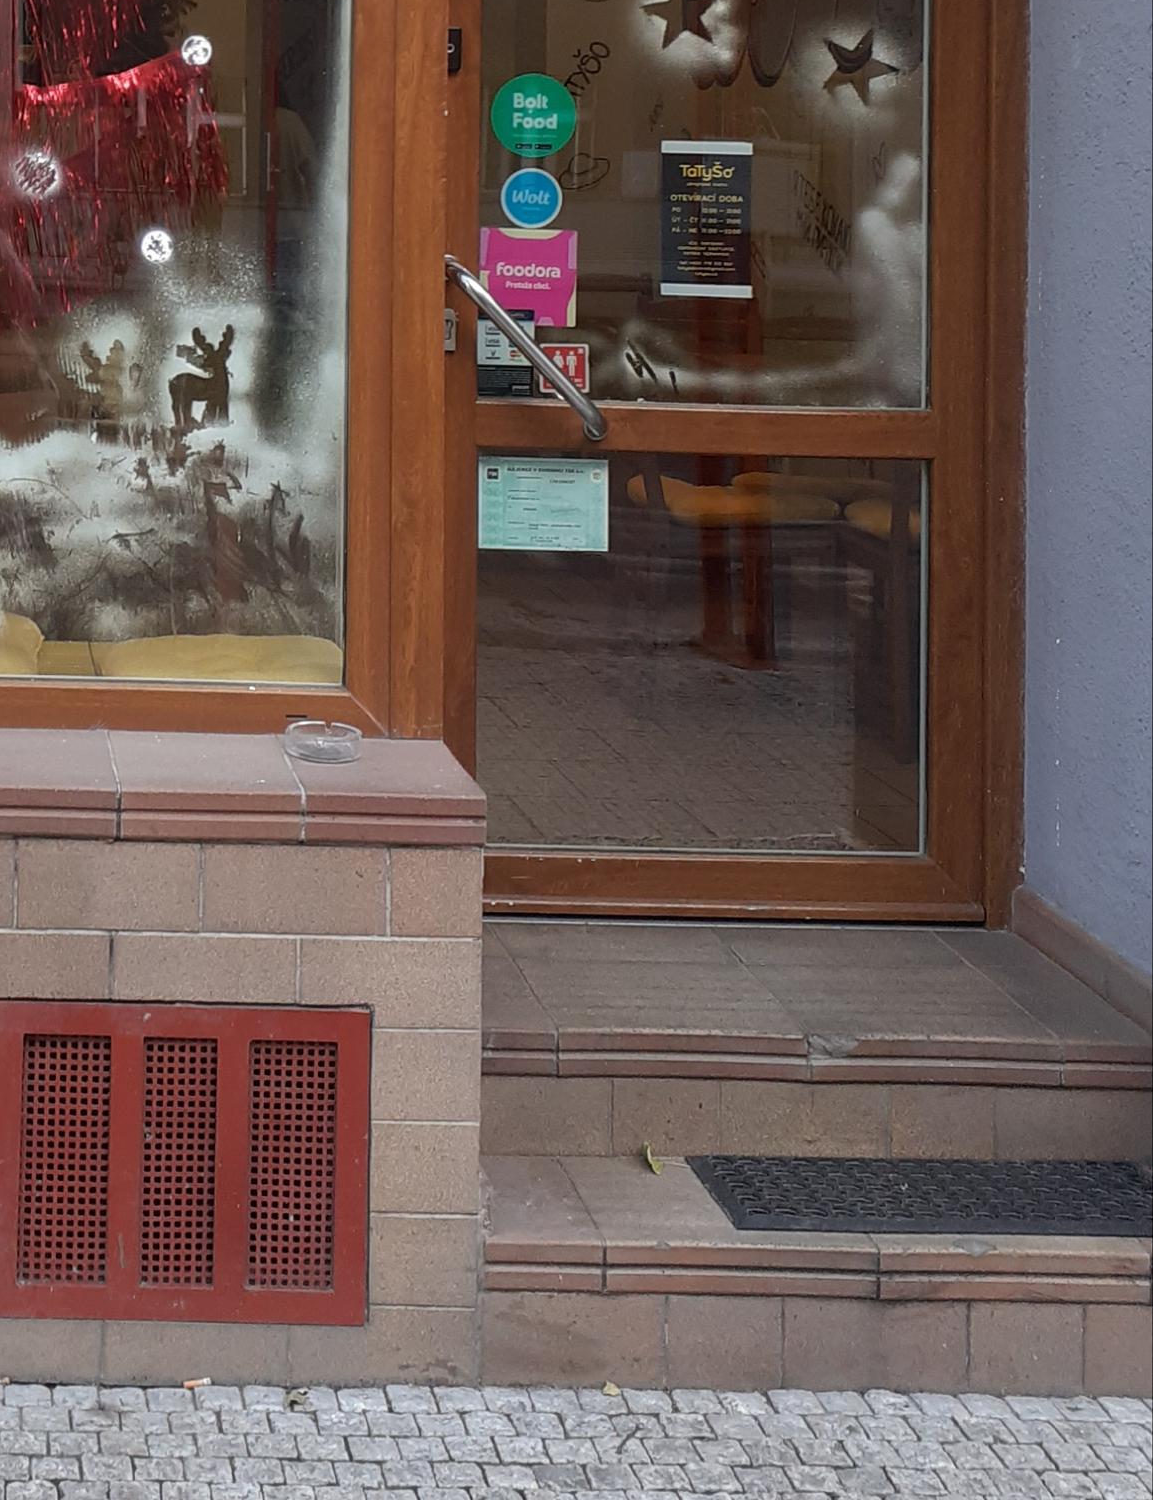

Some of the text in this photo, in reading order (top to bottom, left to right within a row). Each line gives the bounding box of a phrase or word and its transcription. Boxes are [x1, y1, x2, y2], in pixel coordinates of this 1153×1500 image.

[512, 92, 549, 110] Bolt
[512, 112, 558, 130] Food
[511, 188, 551, 205] Wolt
[495, 261, 561, 278] foodora
